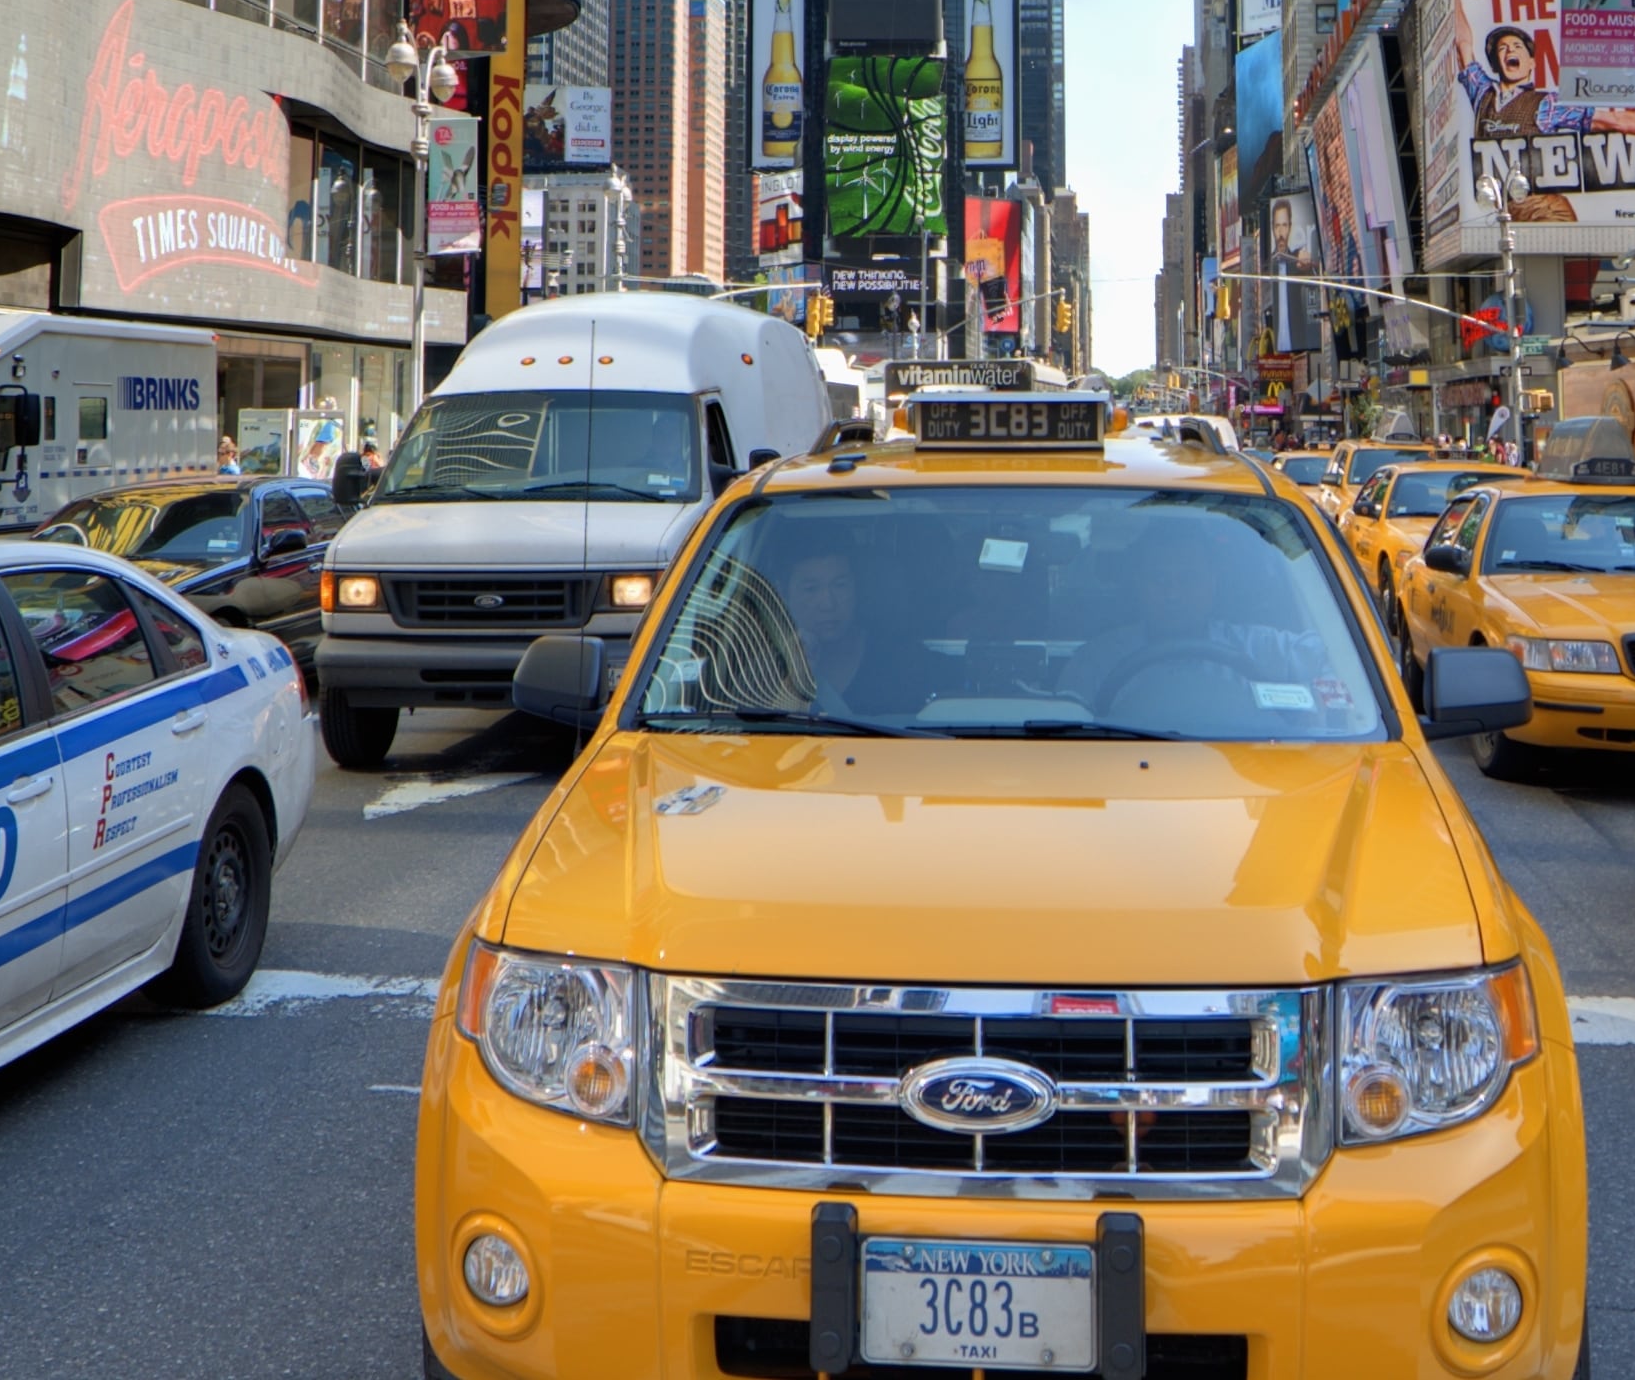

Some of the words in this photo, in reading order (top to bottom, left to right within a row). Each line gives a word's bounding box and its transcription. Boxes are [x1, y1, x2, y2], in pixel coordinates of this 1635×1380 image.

[1565, 13, 1597, 26] FOOD
[1564, 44, 1608, 55] MONDAY,
[1611, 43, 1635, 54] JUNE
[827, 133, 857, 146] display
[859, 133, 897, 146] powered
[830, 145, 839, 154] by
[842, 145, 863, 154] wind
[865, 145, 895, 155] energy
[132, 209, 199, 264] TIMES
[207, 212, 266, 258] SQUARE
[832, 271, 856, 281] NEW
[832, 281, 856, 291] NEW
[896, 364, 1020, 387] vitaminwater
[132, 376, 200, 411] BRINKS
[927, 420, 962, 438] DUTY
[1057, 420, 1091, 438] DUTY
[929, 402, 958, 419] OFF
[969, 405, 1048, 437] 3C83
[1059, 402, 1088, 419] OFF
[105, 751, 152, 781] COURTESY
[101, 769, 179, 815] PROFESSIONALISM
[93, 816, 137, 850] RESPECT
[940, 1077, 1012, 1114] Ford
[919, 1249, 971, 1276] NEW
[973, 1249, 1041, 1276] YORK
[959, 1345, 998, 1359] TAXI
